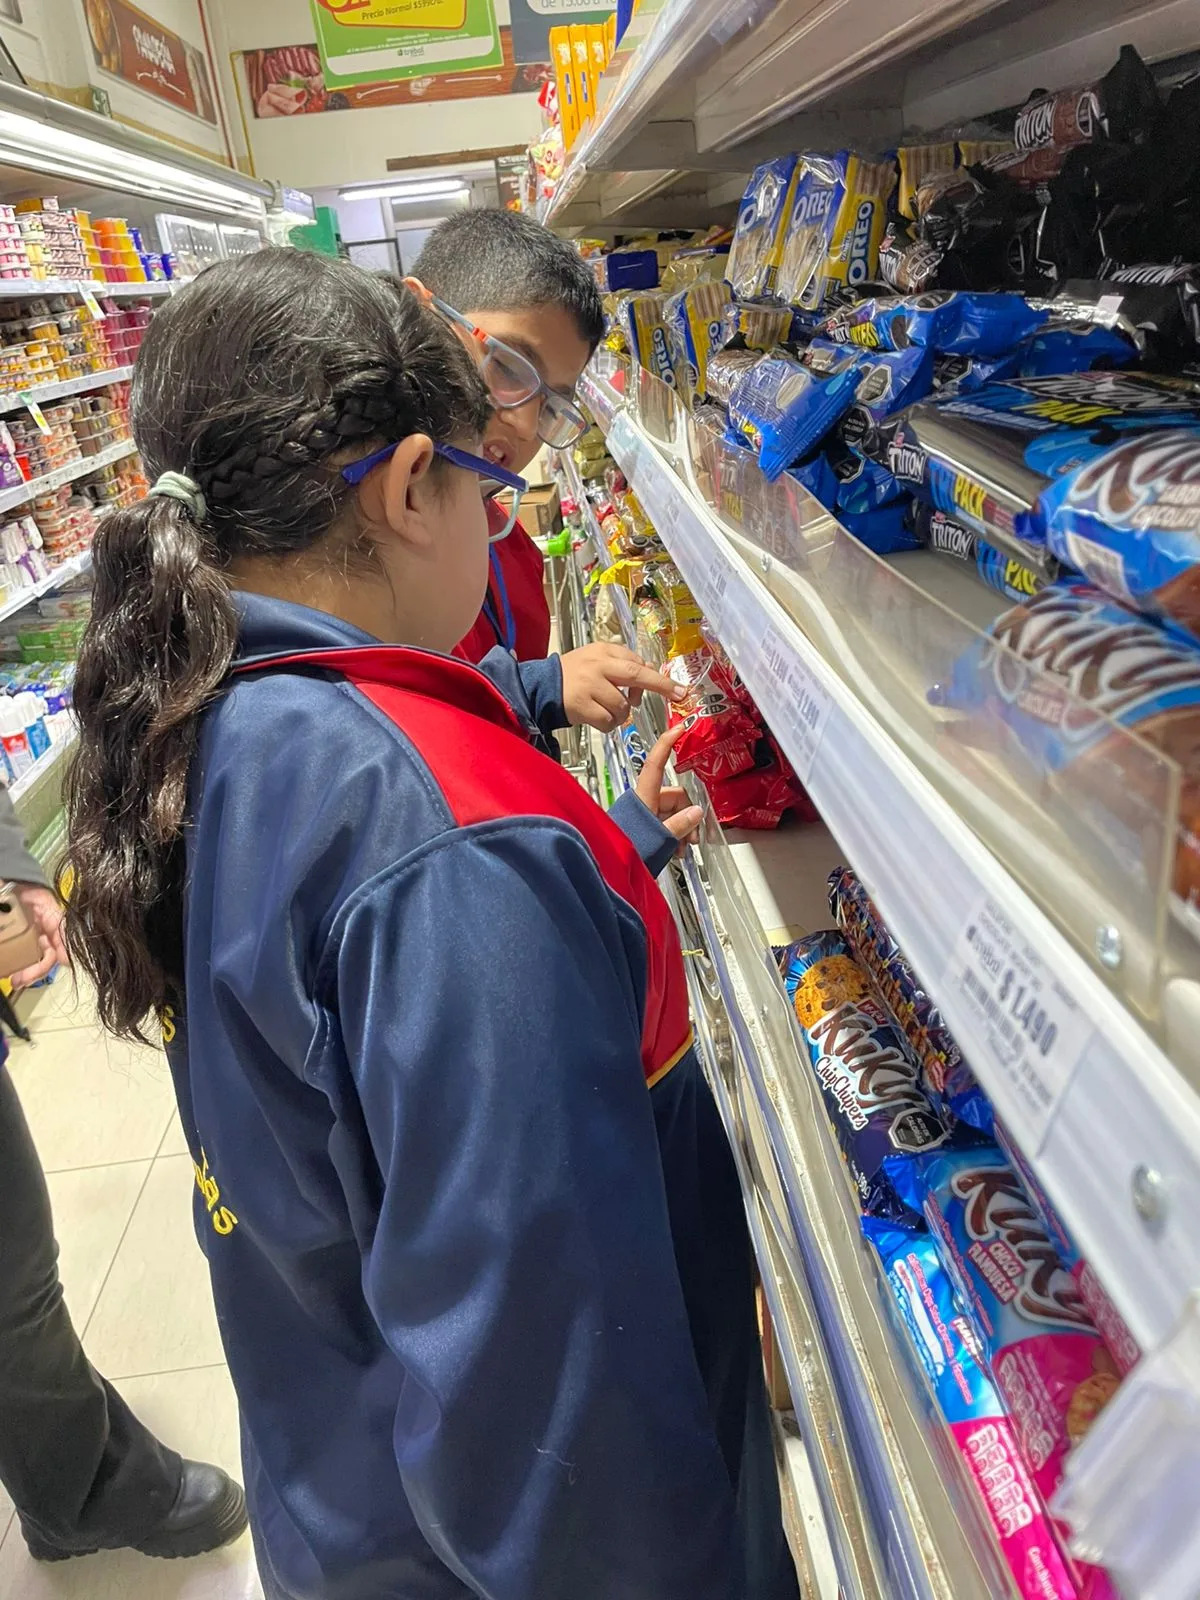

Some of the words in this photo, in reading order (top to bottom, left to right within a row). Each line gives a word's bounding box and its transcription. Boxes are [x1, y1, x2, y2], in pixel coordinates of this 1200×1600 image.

[362, 9, 385, 20] Precio
[385, 2, 412, 15] Normal
[849, 202, 872, 285] OREO
[653, 328, 676, 389] OREO
[888, 447, 925, 478] TRITON
[954, 472, 988, 521] PACK
[932, 521, 973, 556] TRITON
[989, 1241, 1022, 1278] CHOCO
